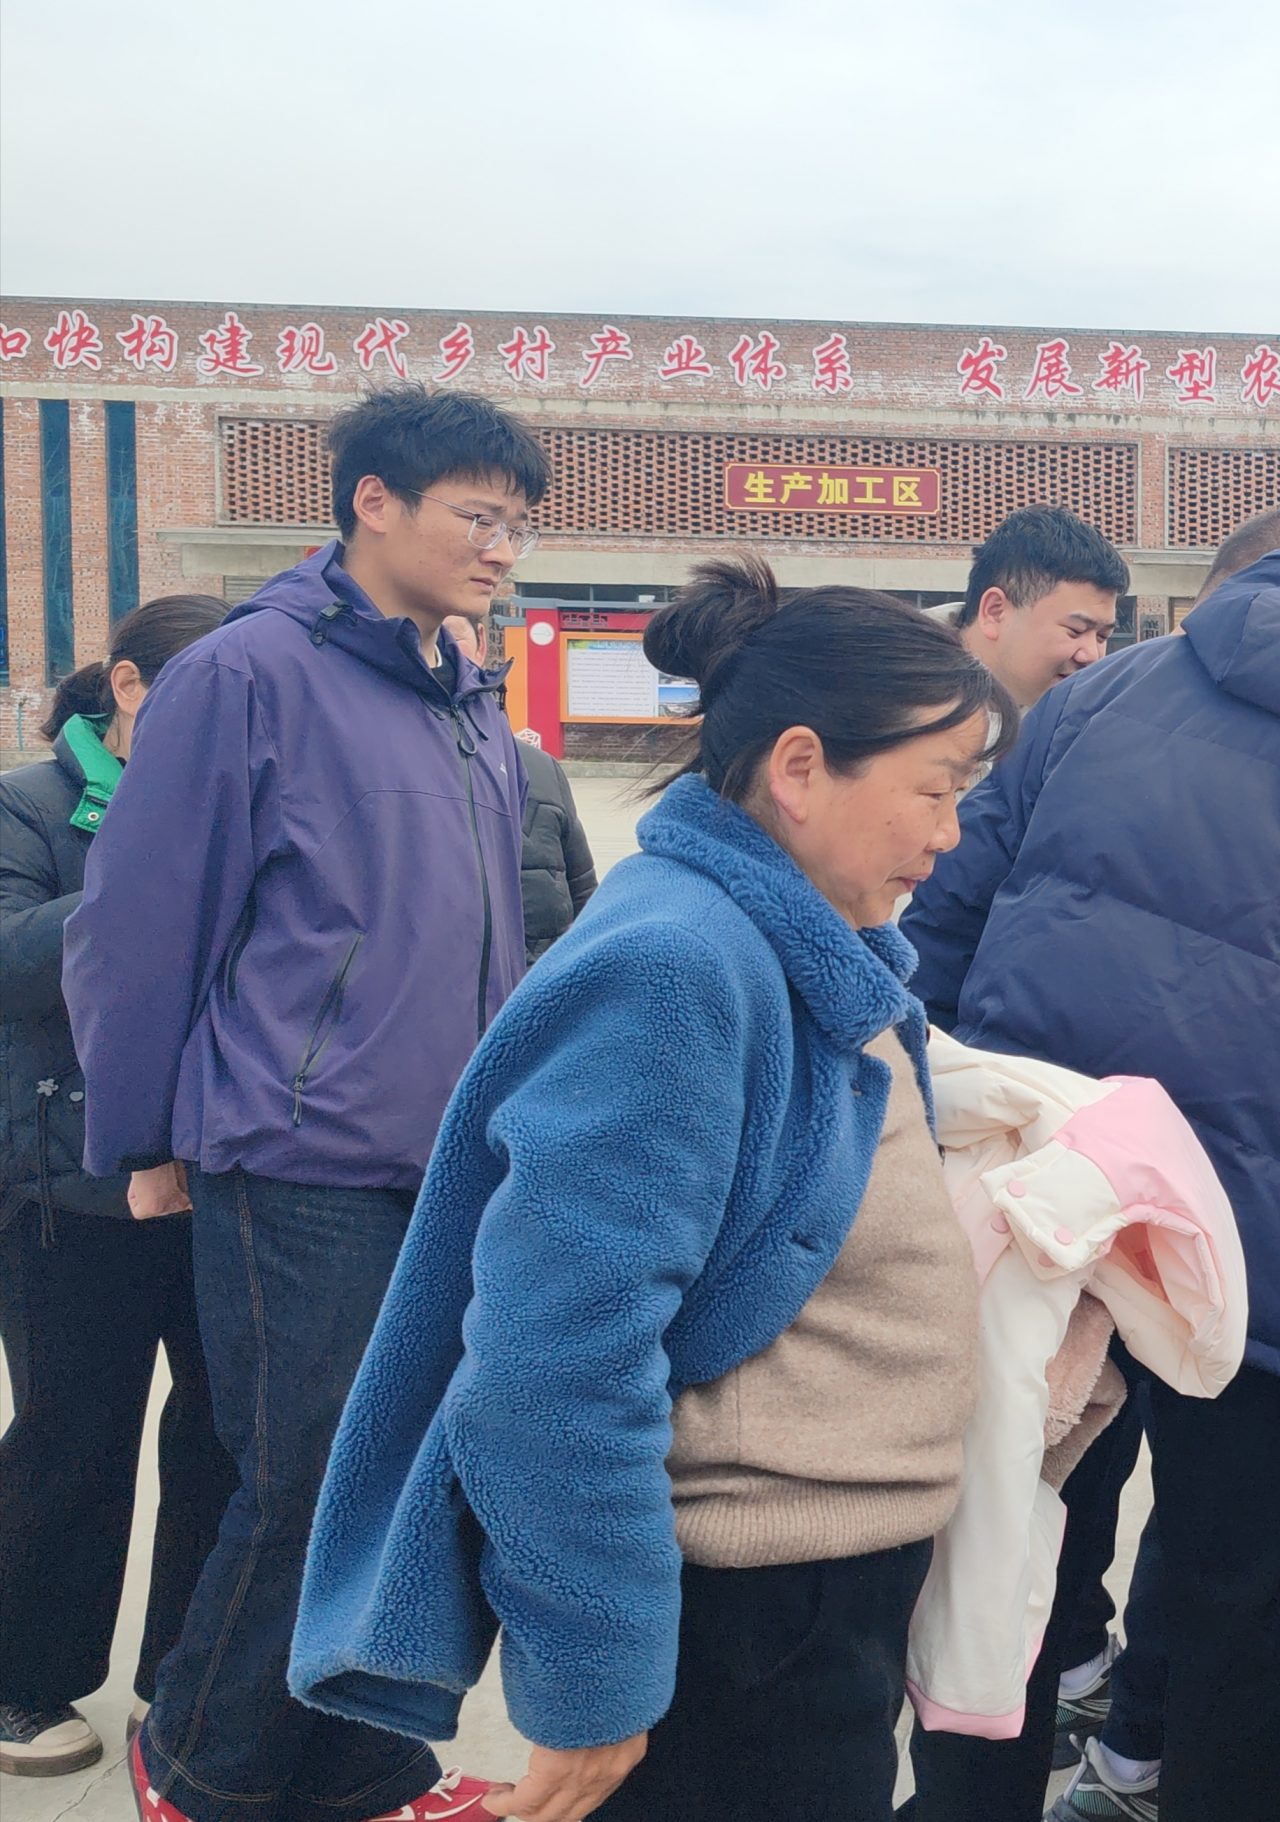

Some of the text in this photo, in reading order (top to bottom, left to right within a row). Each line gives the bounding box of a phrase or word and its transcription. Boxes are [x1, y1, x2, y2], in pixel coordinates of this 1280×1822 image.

[744, 470, 922, 507] 生产加工区
